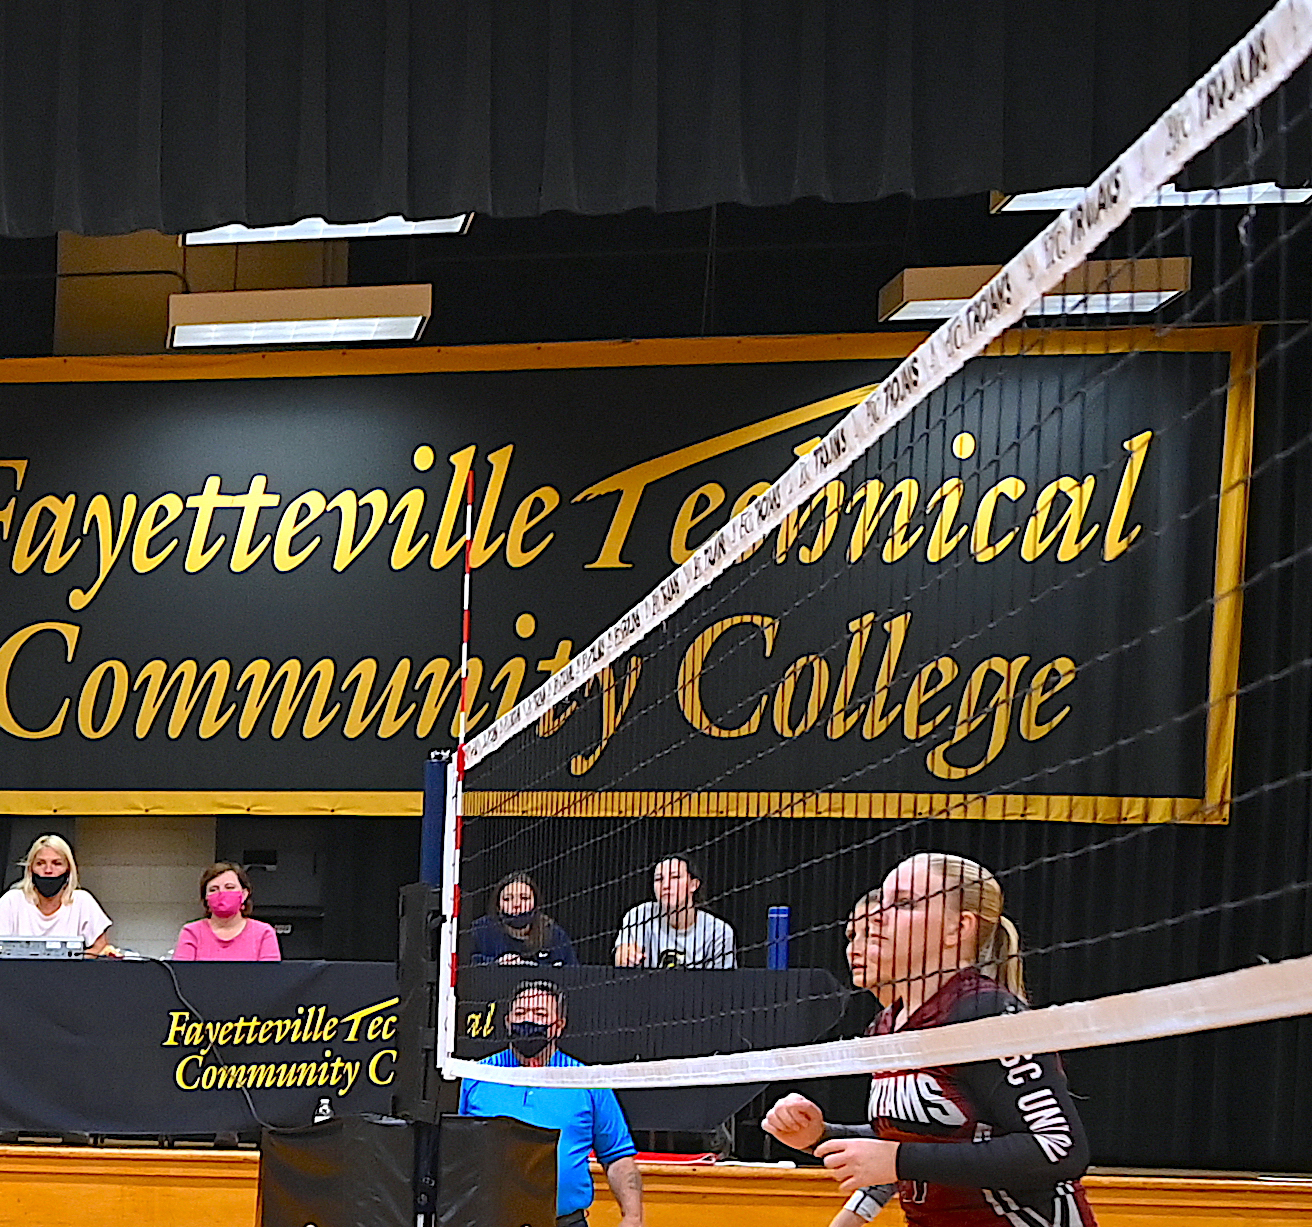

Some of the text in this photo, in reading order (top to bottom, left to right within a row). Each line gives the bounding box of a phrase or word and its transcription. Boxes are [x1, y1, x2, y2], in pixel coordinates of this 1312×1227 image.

[678, 611, 1076, 779] College
[162, 1006, 338, 1055] Fayetteville
[175, 1050, 361, 1096] Community
